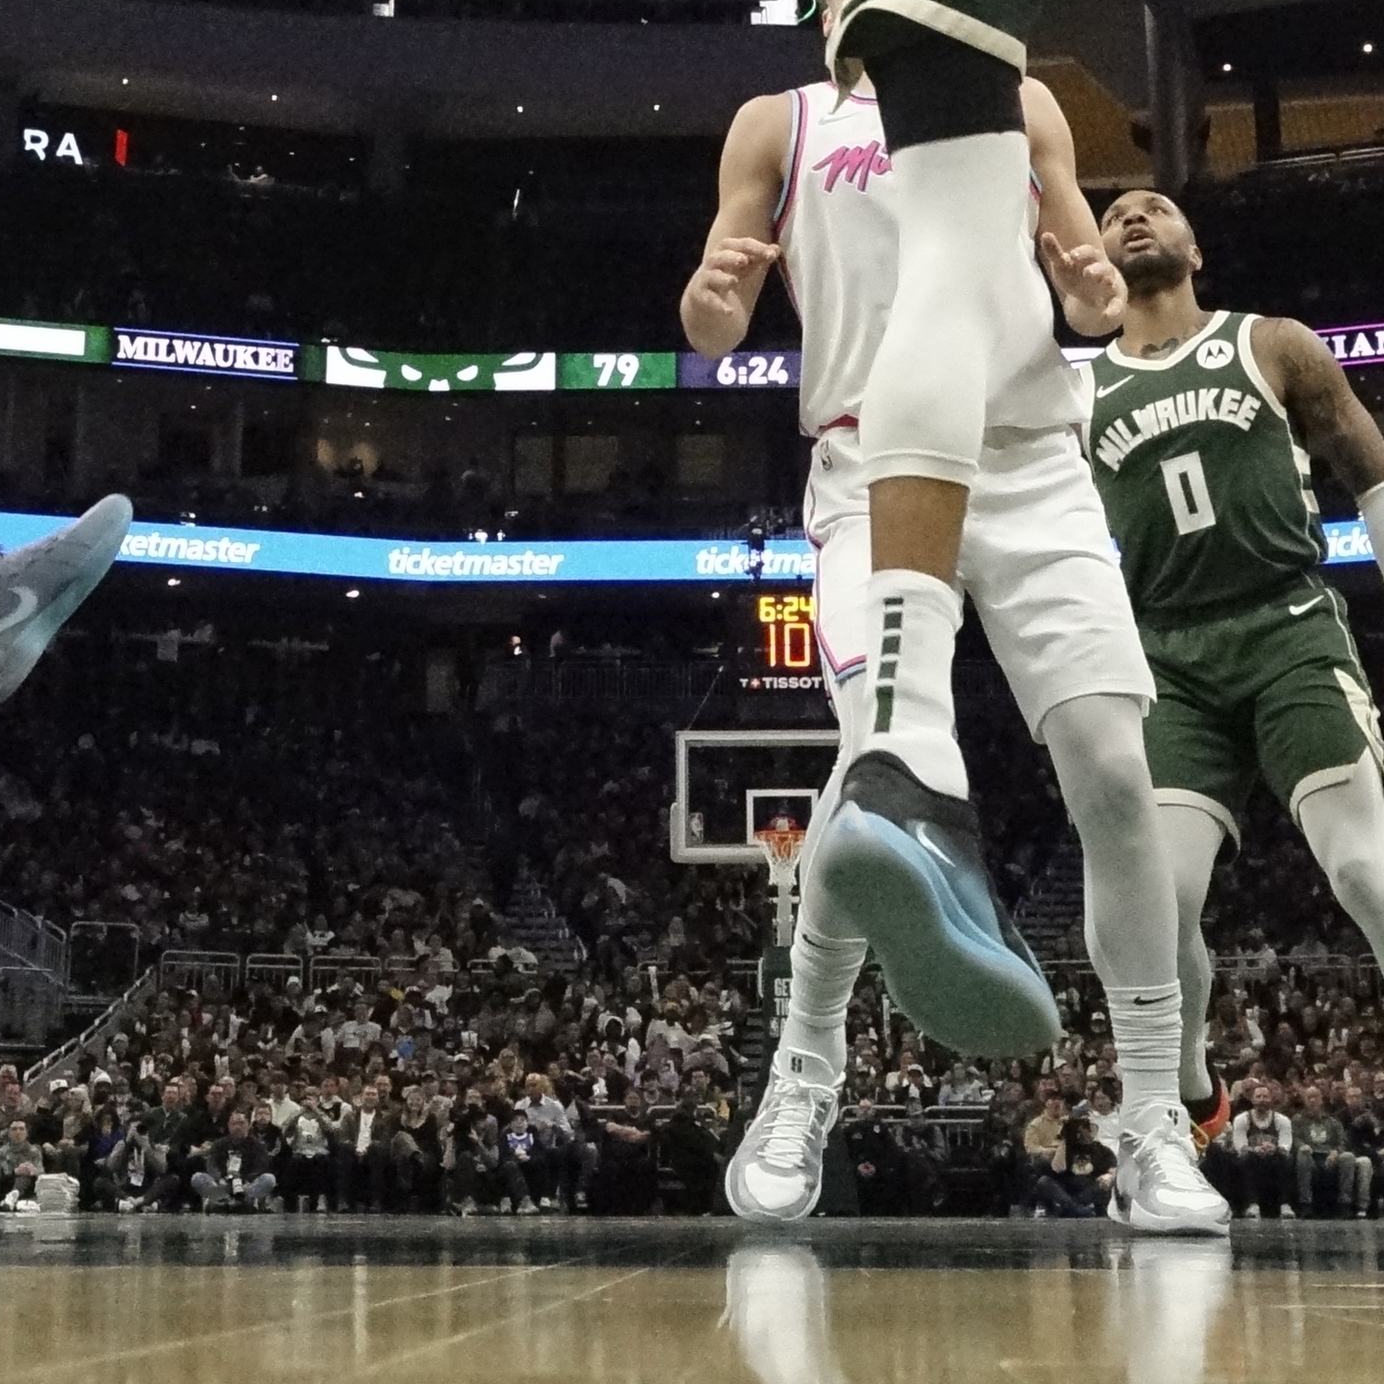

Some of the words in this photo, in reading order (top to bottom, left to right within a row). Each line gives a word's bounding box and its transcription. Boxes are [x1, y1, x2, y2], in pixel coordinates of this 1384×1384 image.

[117, 335, 294, 373] MILWAUKEE
[593, 353, 640, 387] 79
[717, 356, 789, 386] 6:24
[1095, 388, 1261, 472] MILWAUKEE
[1160, 451, 1216, 535] 0
[388, 547, 565, 577] ticketmaster
[759, 596, 816, 622] 6:24
[769, 623, 810, 667] 10
[762, 677, 823, 689] TISSOT
